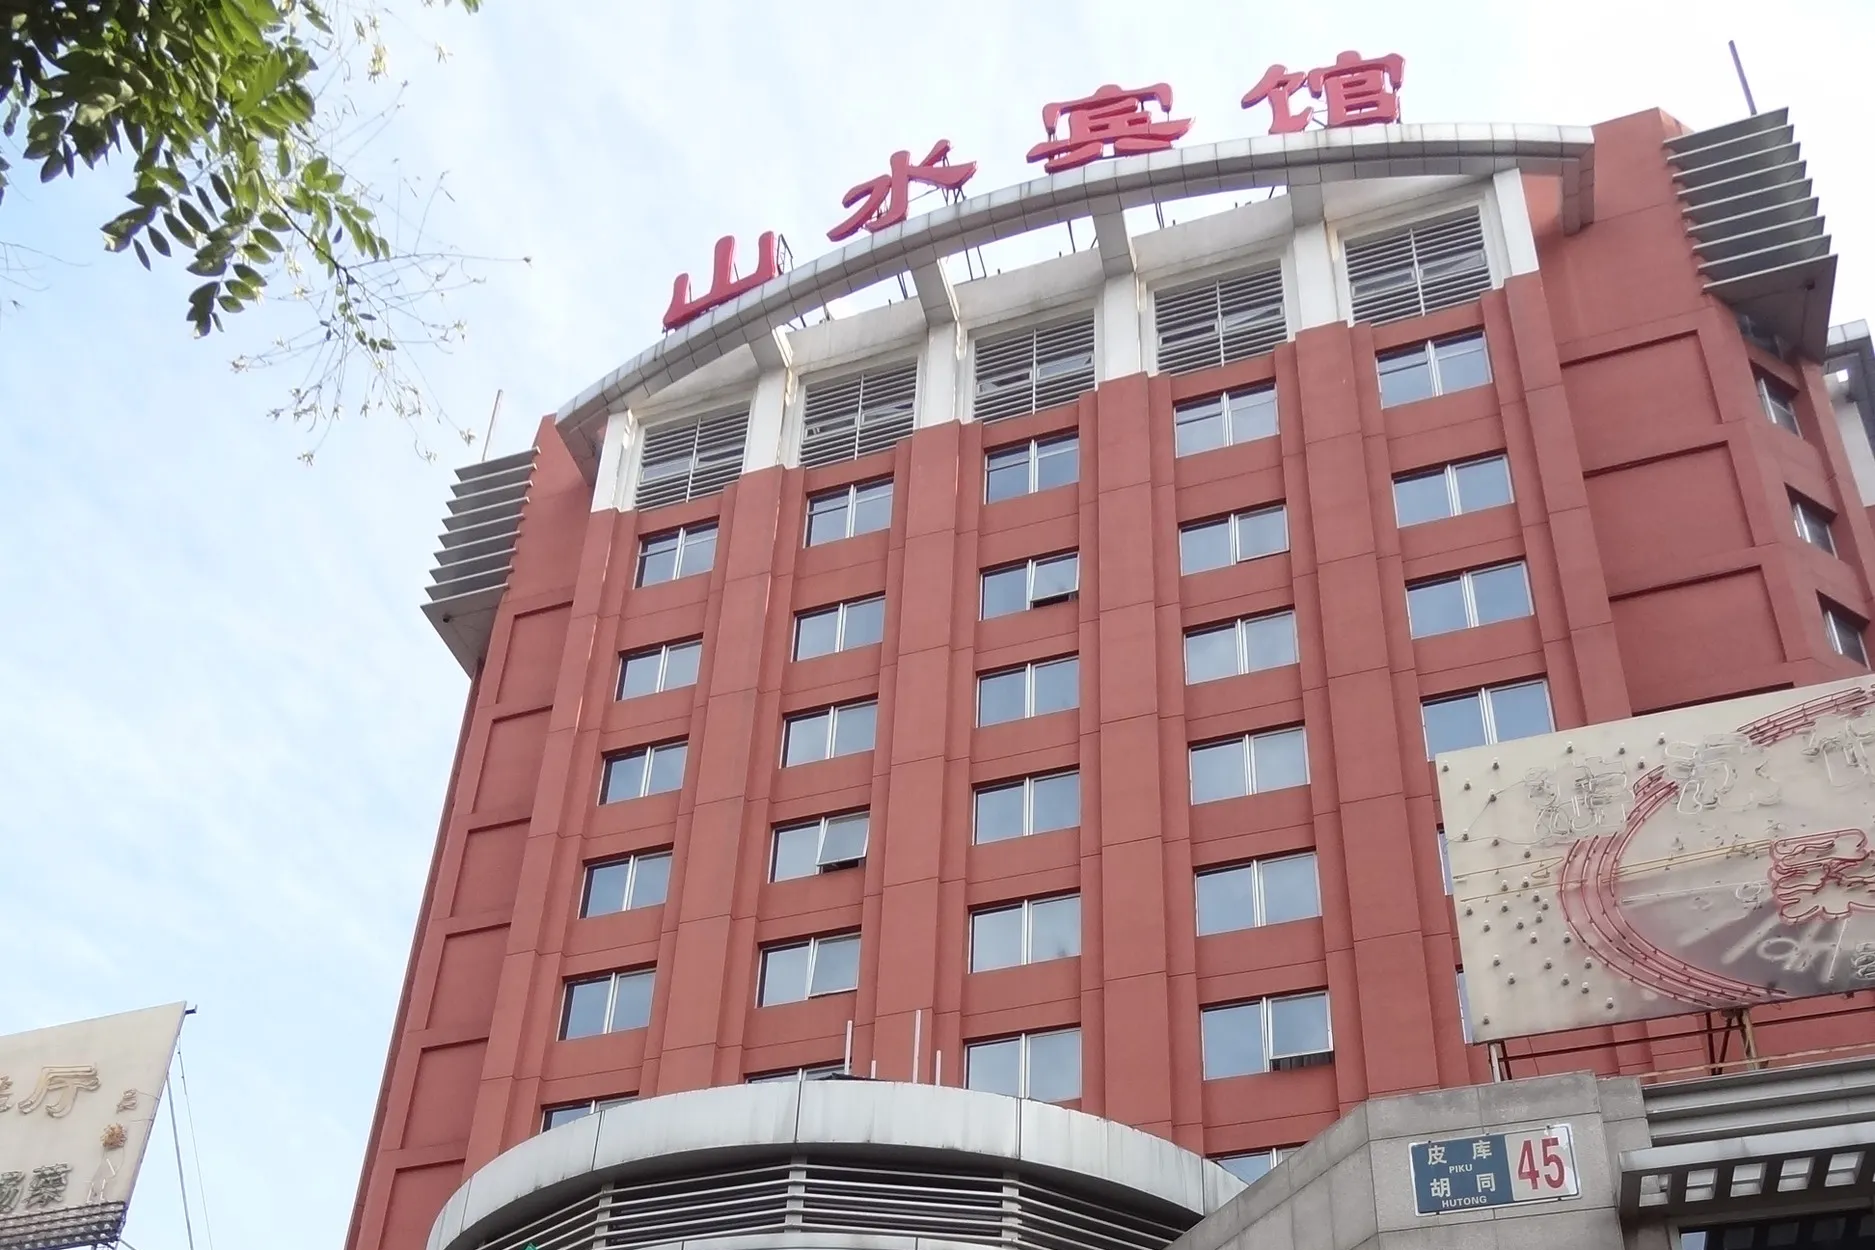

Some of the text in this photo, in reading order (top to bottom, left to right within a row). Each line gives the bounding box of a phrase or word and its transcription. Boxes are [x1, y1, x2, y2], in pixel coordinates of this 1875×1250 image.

[662, 50, 1405, 330] 山水宾馆
[1427, 1139, 1493, 1166] 皮库
[1517, 1136, 1565, 1190] 45
[1448, 1163, 1474, 1174] PIKU
[1430, 1172, 1496, 1199] 胡同
[1441, 1195, 1488, 1208] HUTONG
